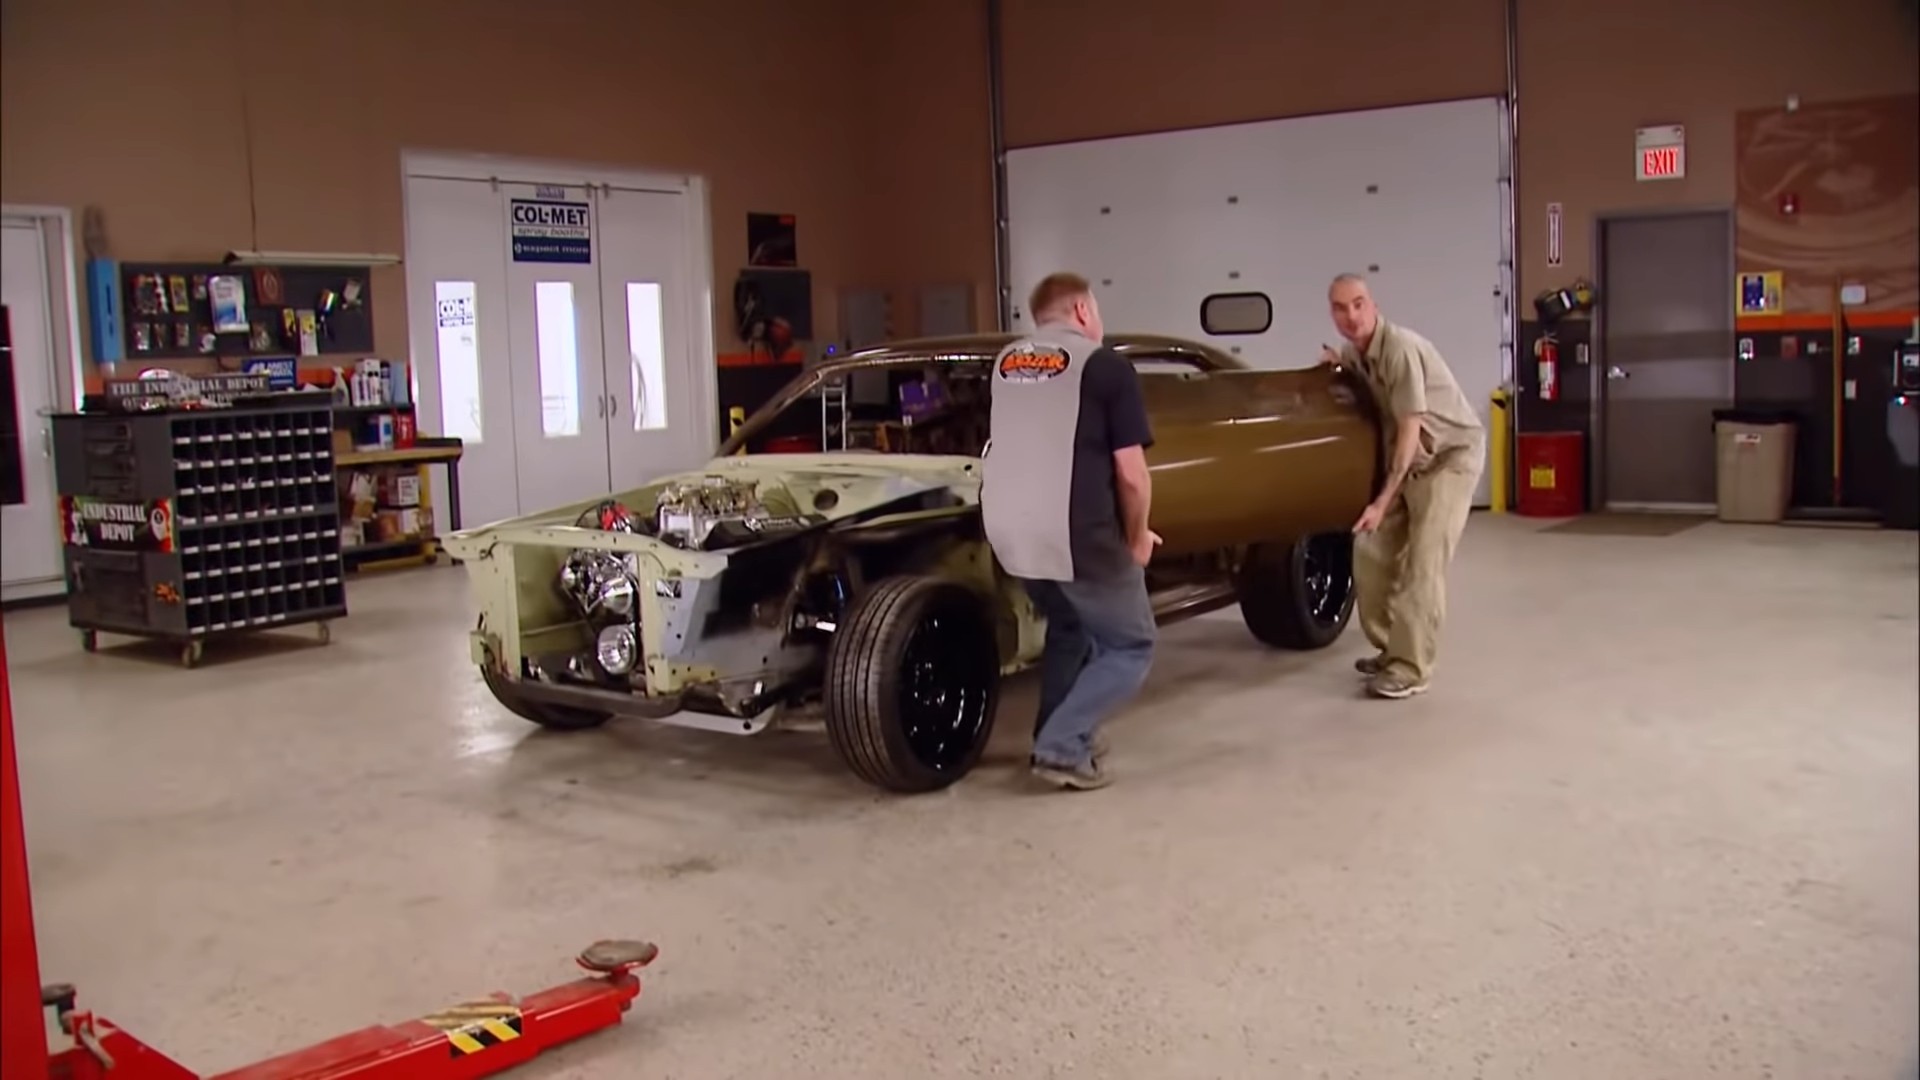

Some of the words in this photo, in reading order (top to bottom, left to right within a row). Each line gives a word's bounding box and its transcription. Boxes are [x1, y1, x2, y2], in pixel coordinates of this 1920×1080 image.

[1644, 148, 1678, 176] EXIT
[111, 382, 139, 396] THE
[145, 378, 222, 396] INDTRIAL
[228, 376, 265, 390] DEPOT
[83, 503, 147, 522] INDUSTRIAL
[101, 523, 135, 542] DEPOT
